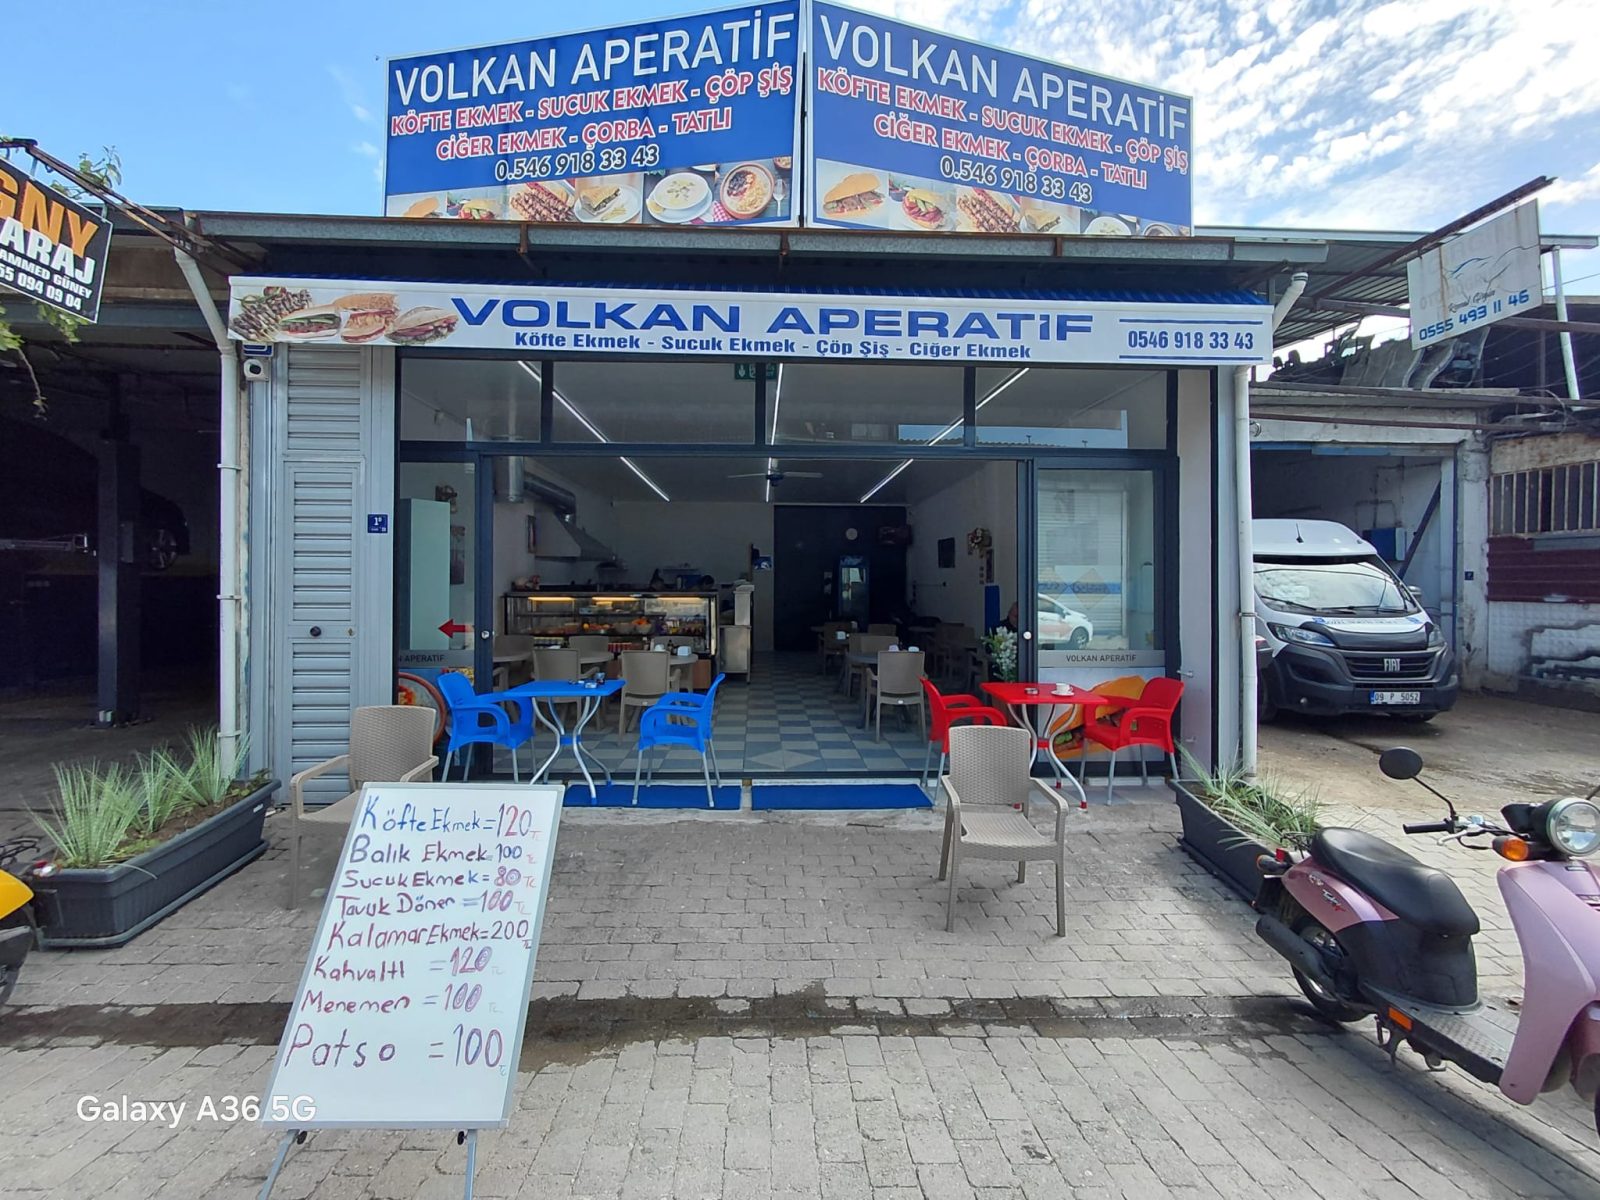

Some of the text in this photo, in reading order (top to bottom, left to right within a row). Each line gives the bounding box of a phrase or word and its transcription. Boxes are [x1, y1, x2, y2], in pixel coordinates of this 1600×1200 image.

[395, 9, 795, 106] VOLKAN APERATİF
[820, 15, 1188, 139] VOLKAN APERATİF
[391, 109, 452, 136] KÖFTE
[456, 101, 524, 129] EKMEK
[538, 90, 610, 119] SUCUK
[613, 80, 689, 110] EKMEK
[705, 69, 753, 103] ÇÖP
[758, 62, 793, 97] ŞİŞ
[436, 132, 494, 160] CİĞER
[497, 127, 567, 154] EKMEK
[582, 117, 656, 150] ÇORBA
[672, 107, 732, 135] TATLI
[818, 67, 890, 104] KÖFTE
[895, 85, 967, 122] EKMEK
[982, 106, 1048, 139] SUCUK
[1051, 121, 1113, 154] EKMEK
[1125, 137, 1161, 164] ÇÖP
[1164, 145, 1188, 174] ŞİŞ
[495, 144, 659, 181] 0.546 918 33 43
[874, 111, 939, 148] CİĞER
[942, 128, 1010, 162] EKMEK
[1025, 146, 1088, 178] ÇORBA
[1100, 162, 1147, 190] TATLI
[940, 155, 1092, 203] 0.546 918 33 43
[17, 271, 44, 294] 094
[46, 284, 63, 302] 09
[65, 293, 82, 310] 04
[53, 272, 93, 299] GÜNEY
[451, 297, 1093, 341] VOLKAN APERATİF
[1419, 318, 1454, 341] 0555
[1458, 305, 1488, 325] 493
[1508, 289, 1529, 306] 46
[515, 332, 566, 347] Köfte
[573, 333, 640, 348] Ekmek
[661, 336, 722, 351] Sucuk
[729, 338, 795, 353] Ekmek
[816, 340, 852, 356] Çöp
[859, 341, 889, 358] Şiş
[909, 342, 960, 358] Ciğer
[966, 344, 1031, 358] Ekmek
[1128, 331, 1253, 349] 0546 918 33 43
[1065, 654, 1098, 663] VOLKAN
[1384, 658, 1400, 672] FIAT
[1374, 692, 1384, 701] 09
[1400, 692, 1418, 701] 5052
[360, 795, 426, 832] Köfte
[431, 806, 481, 833] Ekmek
[349, 834, 410, 863] Balık
[422, 841, 487, 863] Ekmek
[341, 870, 408, 889] Sucuk
[412, 870, 478, 887] Ekmek
[335, 895, 391, 919] Tavuk
[301, 989, 410, 1013] Menemen
